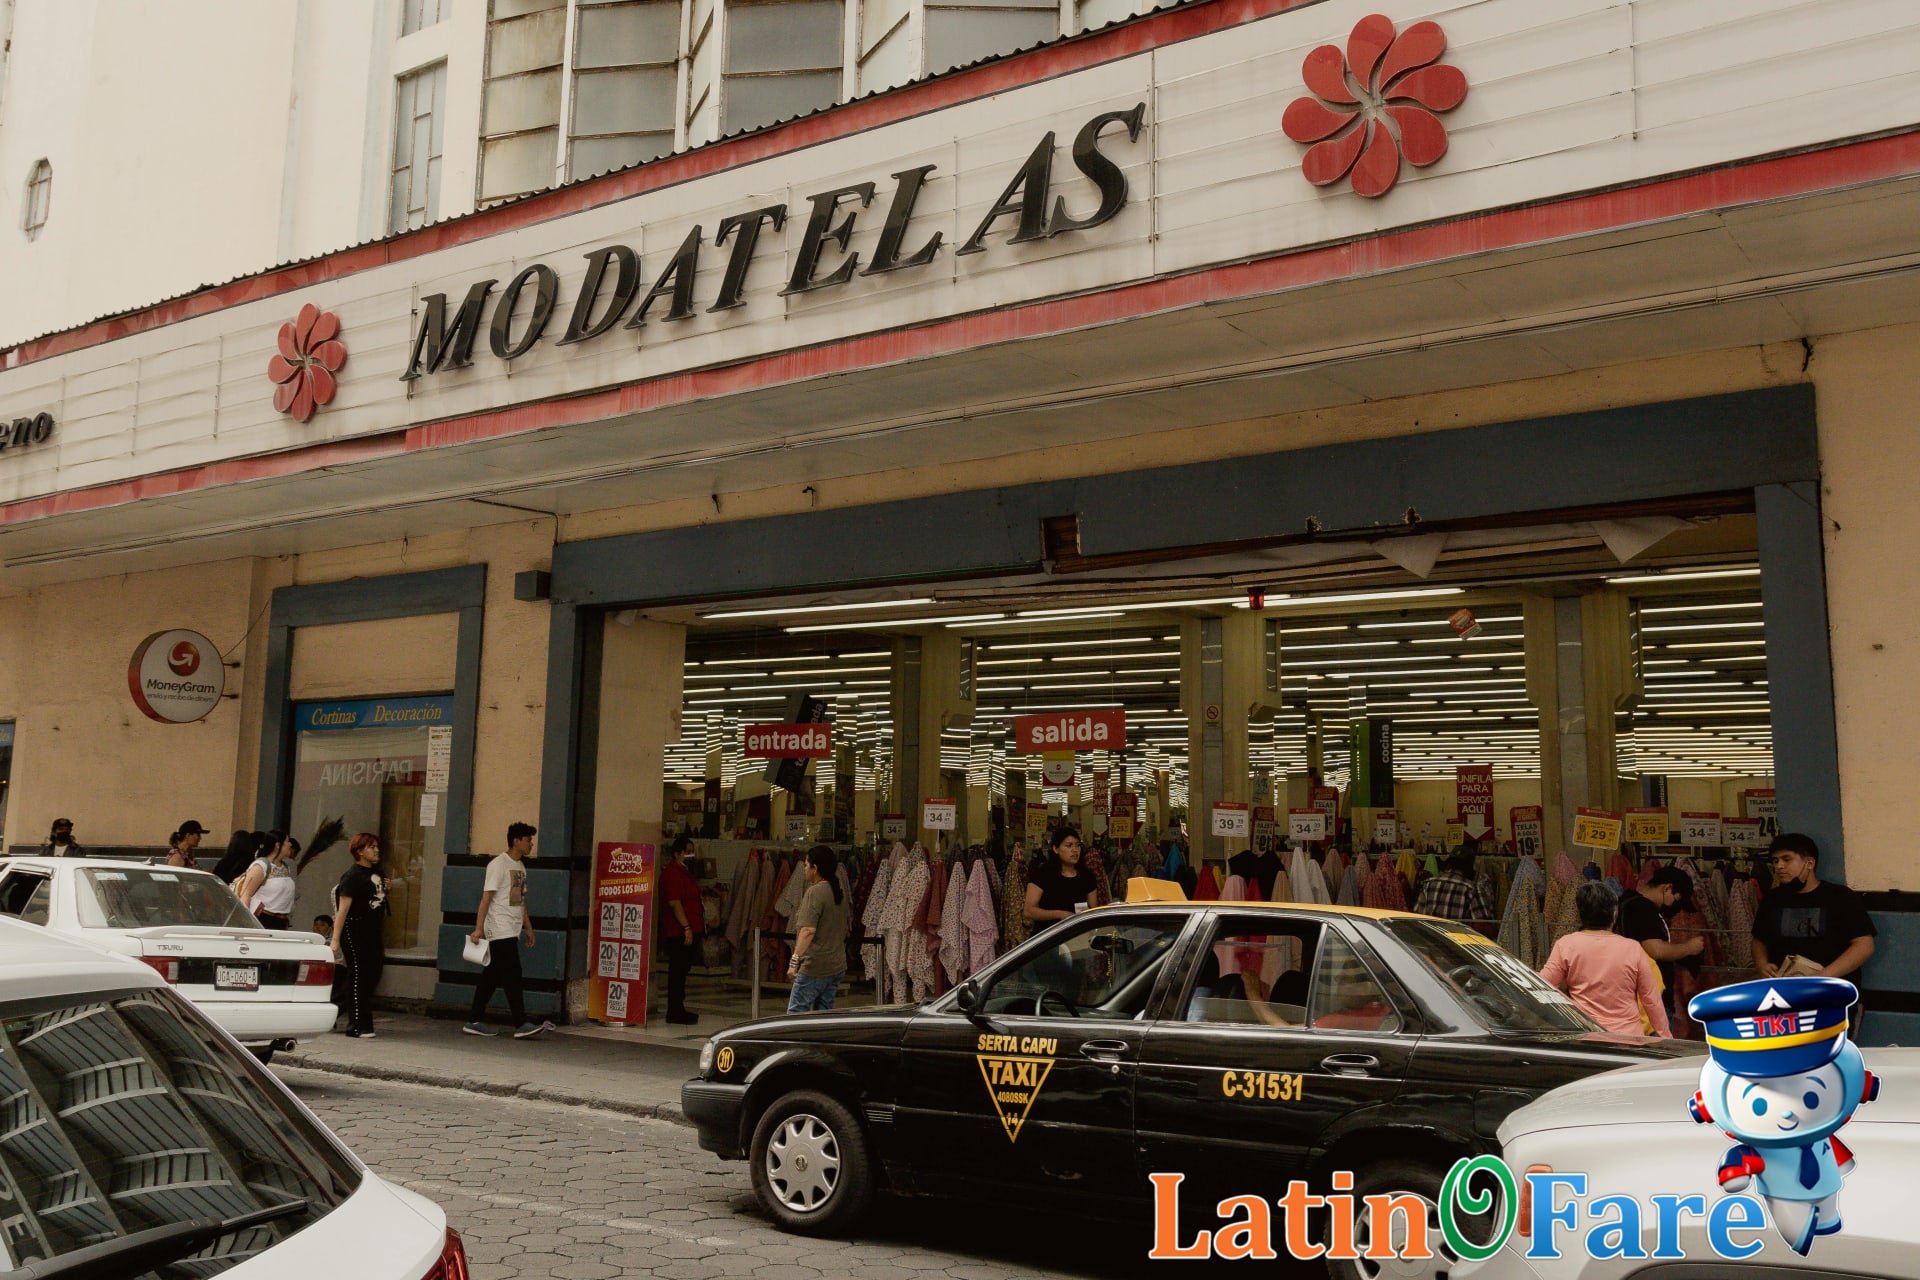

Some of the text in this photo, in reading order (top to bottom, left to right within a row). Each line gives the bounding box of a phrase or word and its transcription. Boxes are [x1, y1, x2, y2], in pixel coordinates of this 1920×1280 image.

[400, 102, 1146, 381] MODATELAS
[311, 703, 442, 726] Cortinas Decoración
[1031, 717, 1108, 743] salida
[748, 728, 827, 750] entrada
[1379, 724, 1390, 763] cocina
[1457, 774, 1492, 783] UNIFILA
[1462, 784, 1488, 793] PARA
[1457, 796, 1493, 804] SERVICIO
[1462, 803, 1486, 813] AQUÍ
[930, 813, 942, 822] 34
[789, 823, 798, 831] 34
[1219, 819, 1234, 829] 39
[1296, 824, 1311, 833] 34
[888, 826, 897, 834] 34
[1591, 830, 1606, 840] 29
[1642, 826, 1656, 834] 39
[1689, 828, 1705, 837] 34
[1729, 832, 1745, 841] 34
[1518, 837, 1534, 857] 19
[622, 884, 633, 895] LOS
[977, 1033, 1057, 1055] SERTA CAPU
[720, 1050, 731, 1068] 311
[988, 1061, 1038, 1087] TAXI
[1222, 1070, 1303, 1101] C-31531
